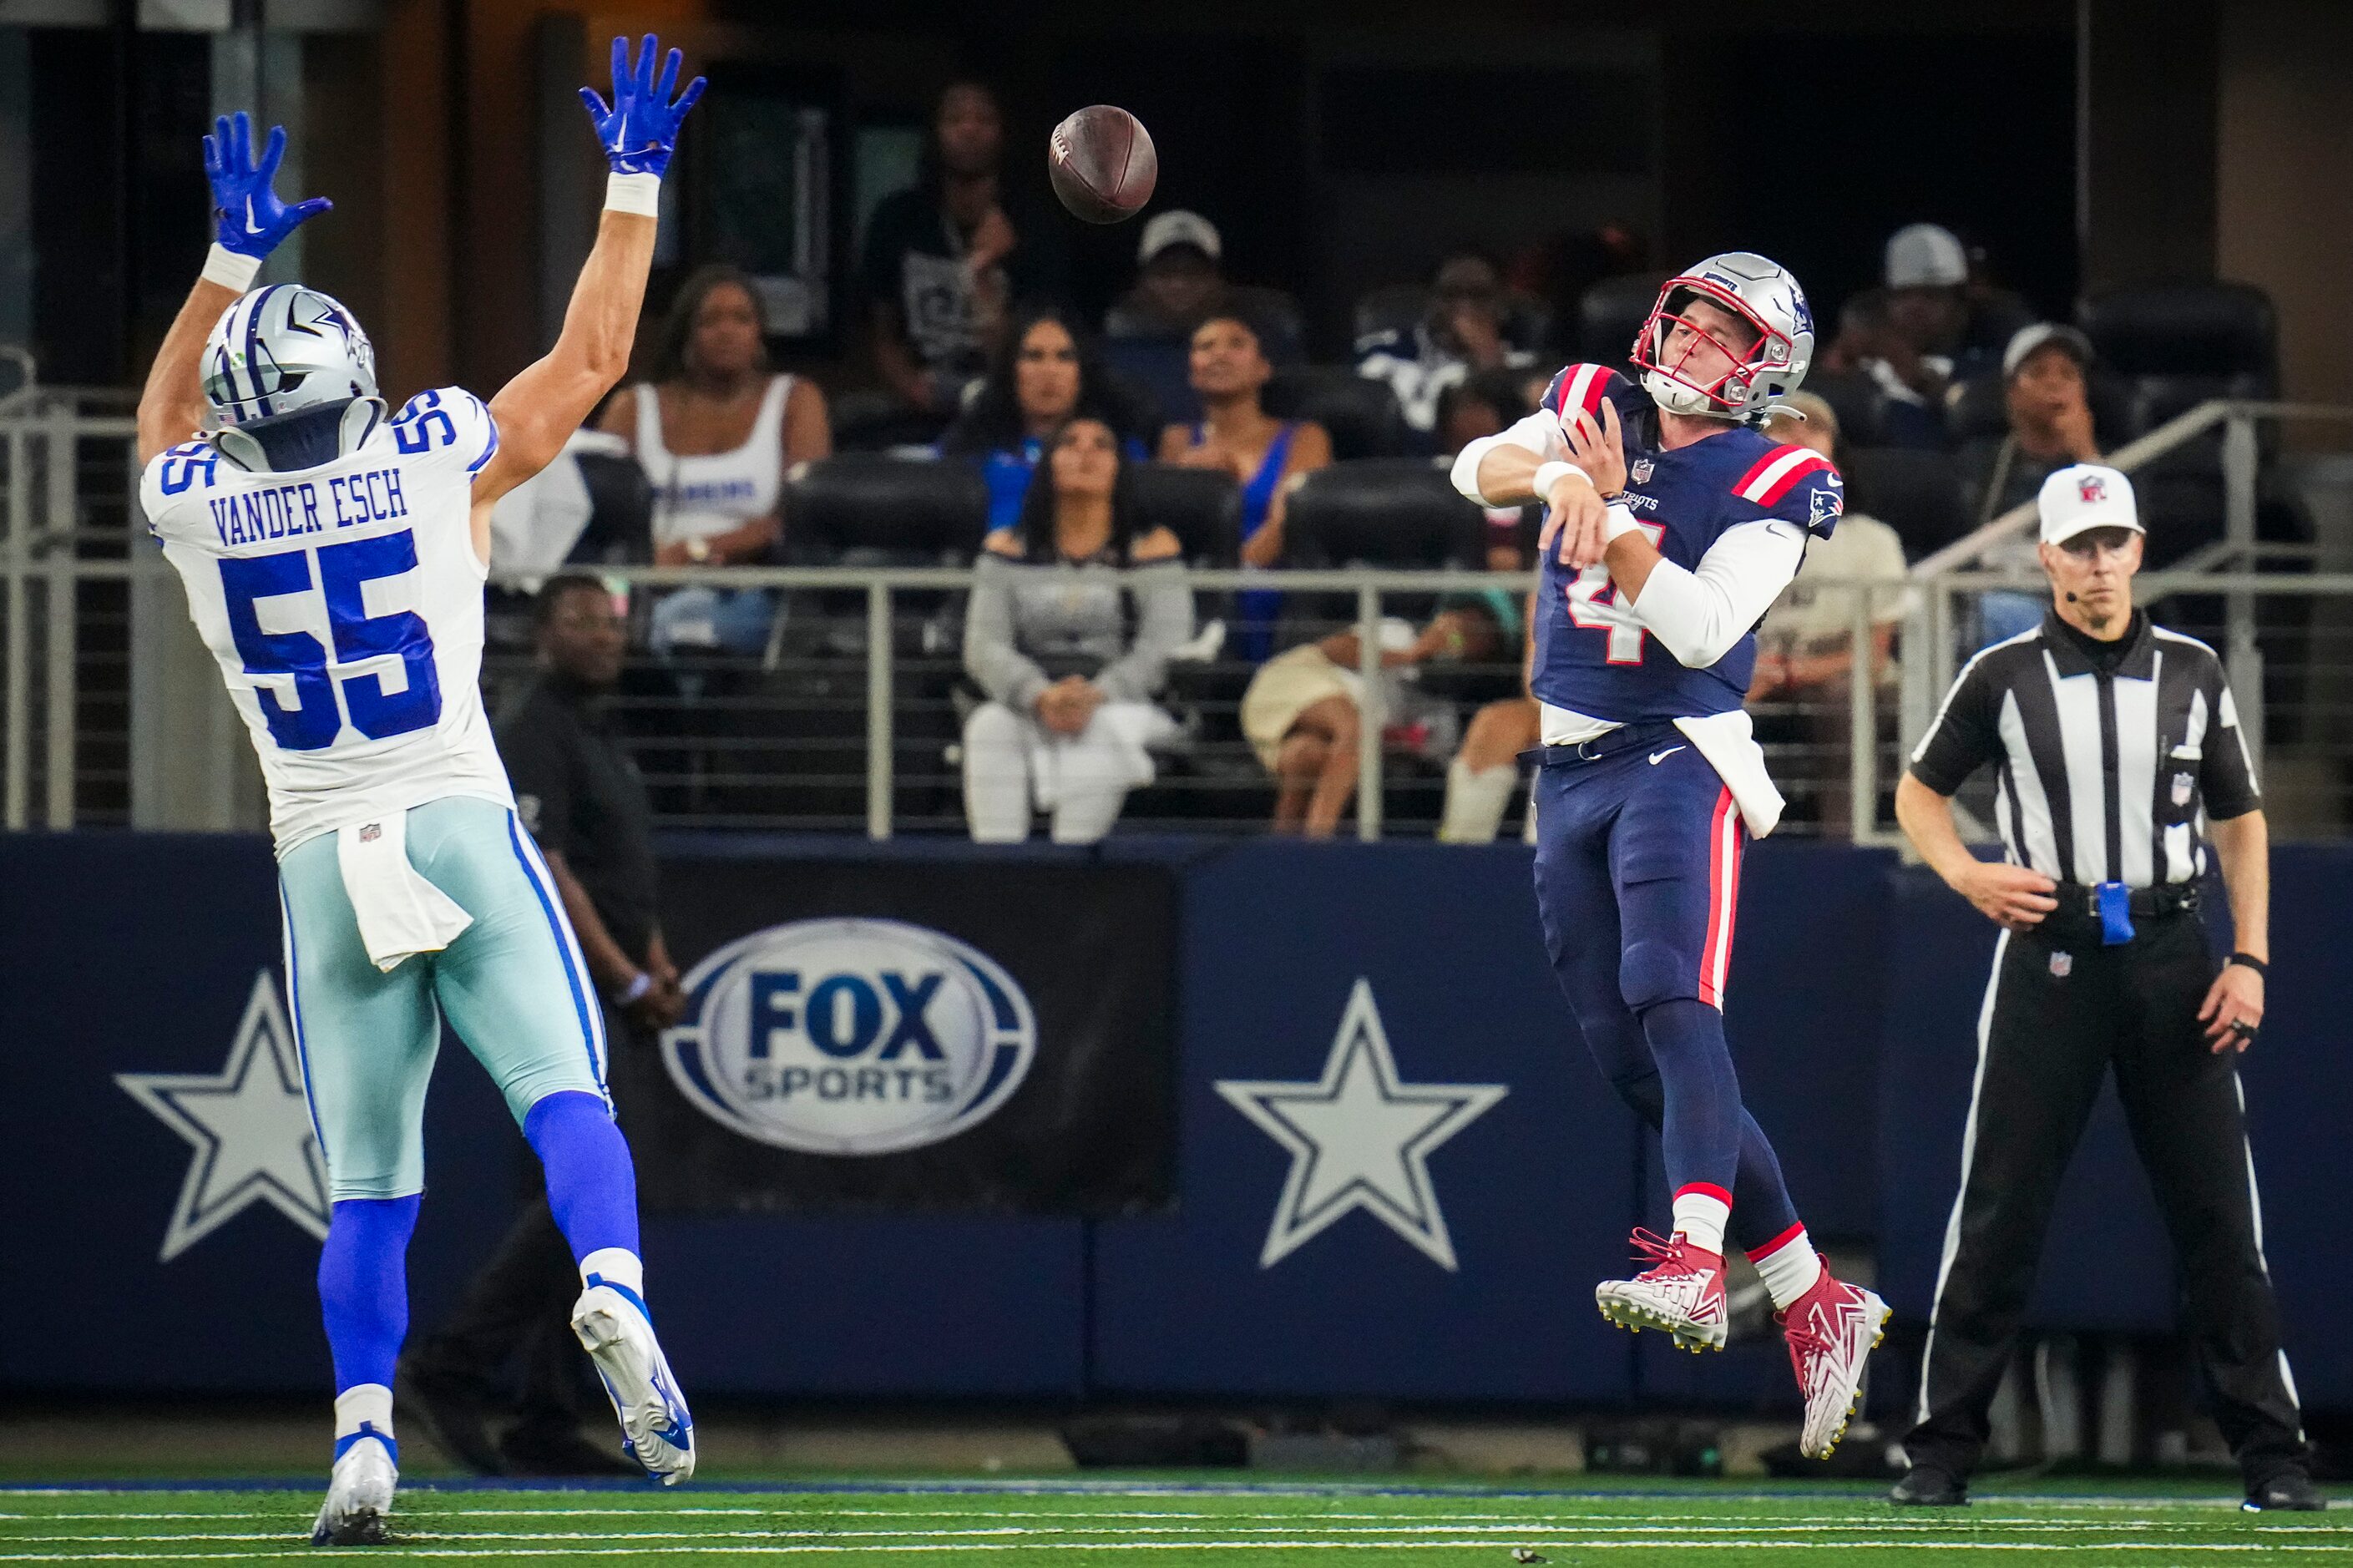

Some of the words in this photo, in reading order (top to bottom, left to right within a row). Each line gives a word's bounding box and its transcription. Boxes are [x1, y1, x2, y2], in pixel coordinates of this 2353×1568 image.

[391, 389, 456, 454] 55
[210, 483, 322, 547] VANDER
[329, 468, 408, 528] ESCH
[1622, 490, 1659, 510] TRIOTS
[1566, 519, 1667, 665] 4
[217, 528, 443, 751] 55
[749, 972, 945, 1060] FOX
[746, 1066, 954, 1103] SPORTS
